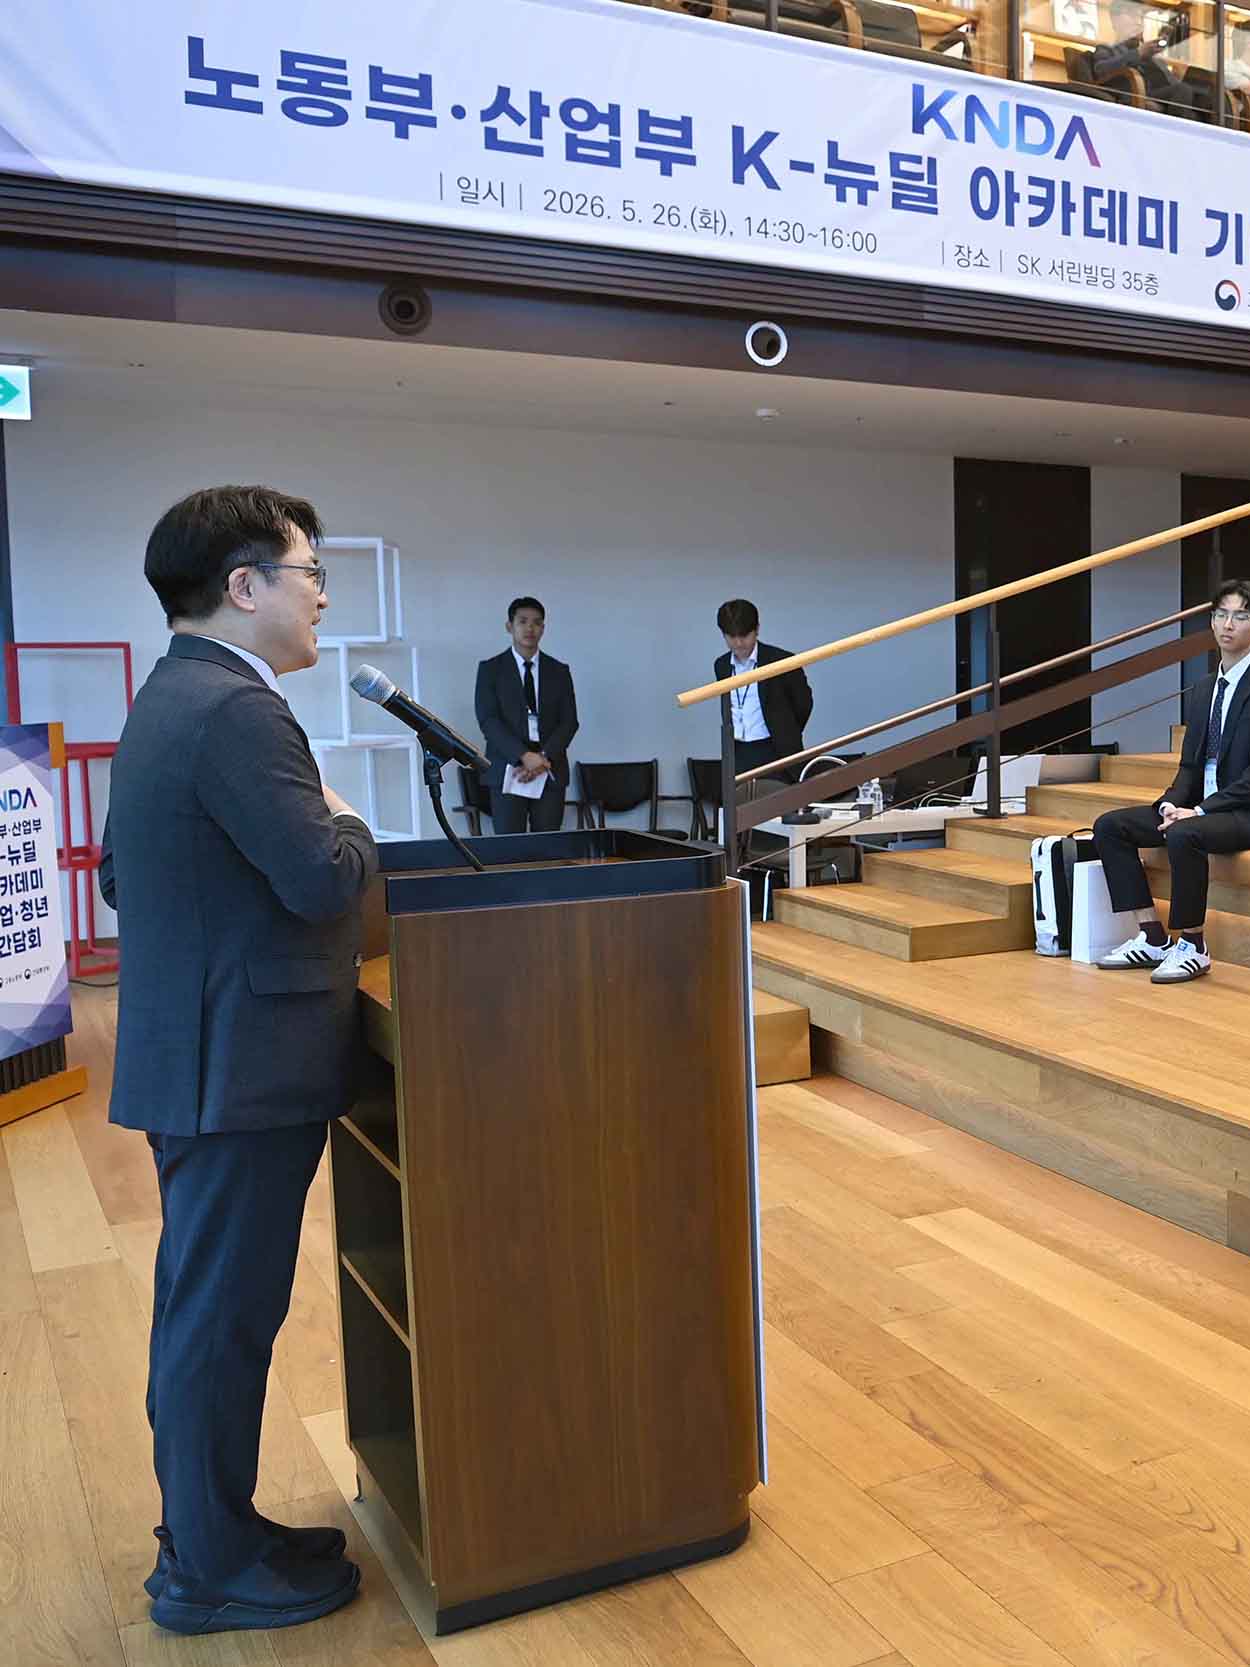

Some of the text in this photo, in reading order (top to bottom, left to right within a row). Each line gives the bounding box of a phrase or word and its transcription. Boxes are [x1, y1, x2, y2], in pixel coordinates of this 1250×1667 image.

[184, 35, 697, 177] 노동부·산업부
[731, 124, 939, 216] K-뉴딜
[969, 165, 1179, 255] 아카데미
[912, 83, 1102, 168] KNDA
[456, 176, 505, 208] 일시
[543, 188, 611, 220] 2026.
[621, 199, 643, 224] 5.
[744, 216, 878, 254] 14:30~16:00
[954, 243, 1160, 297] 장소 SK 서린빌딩 35층
